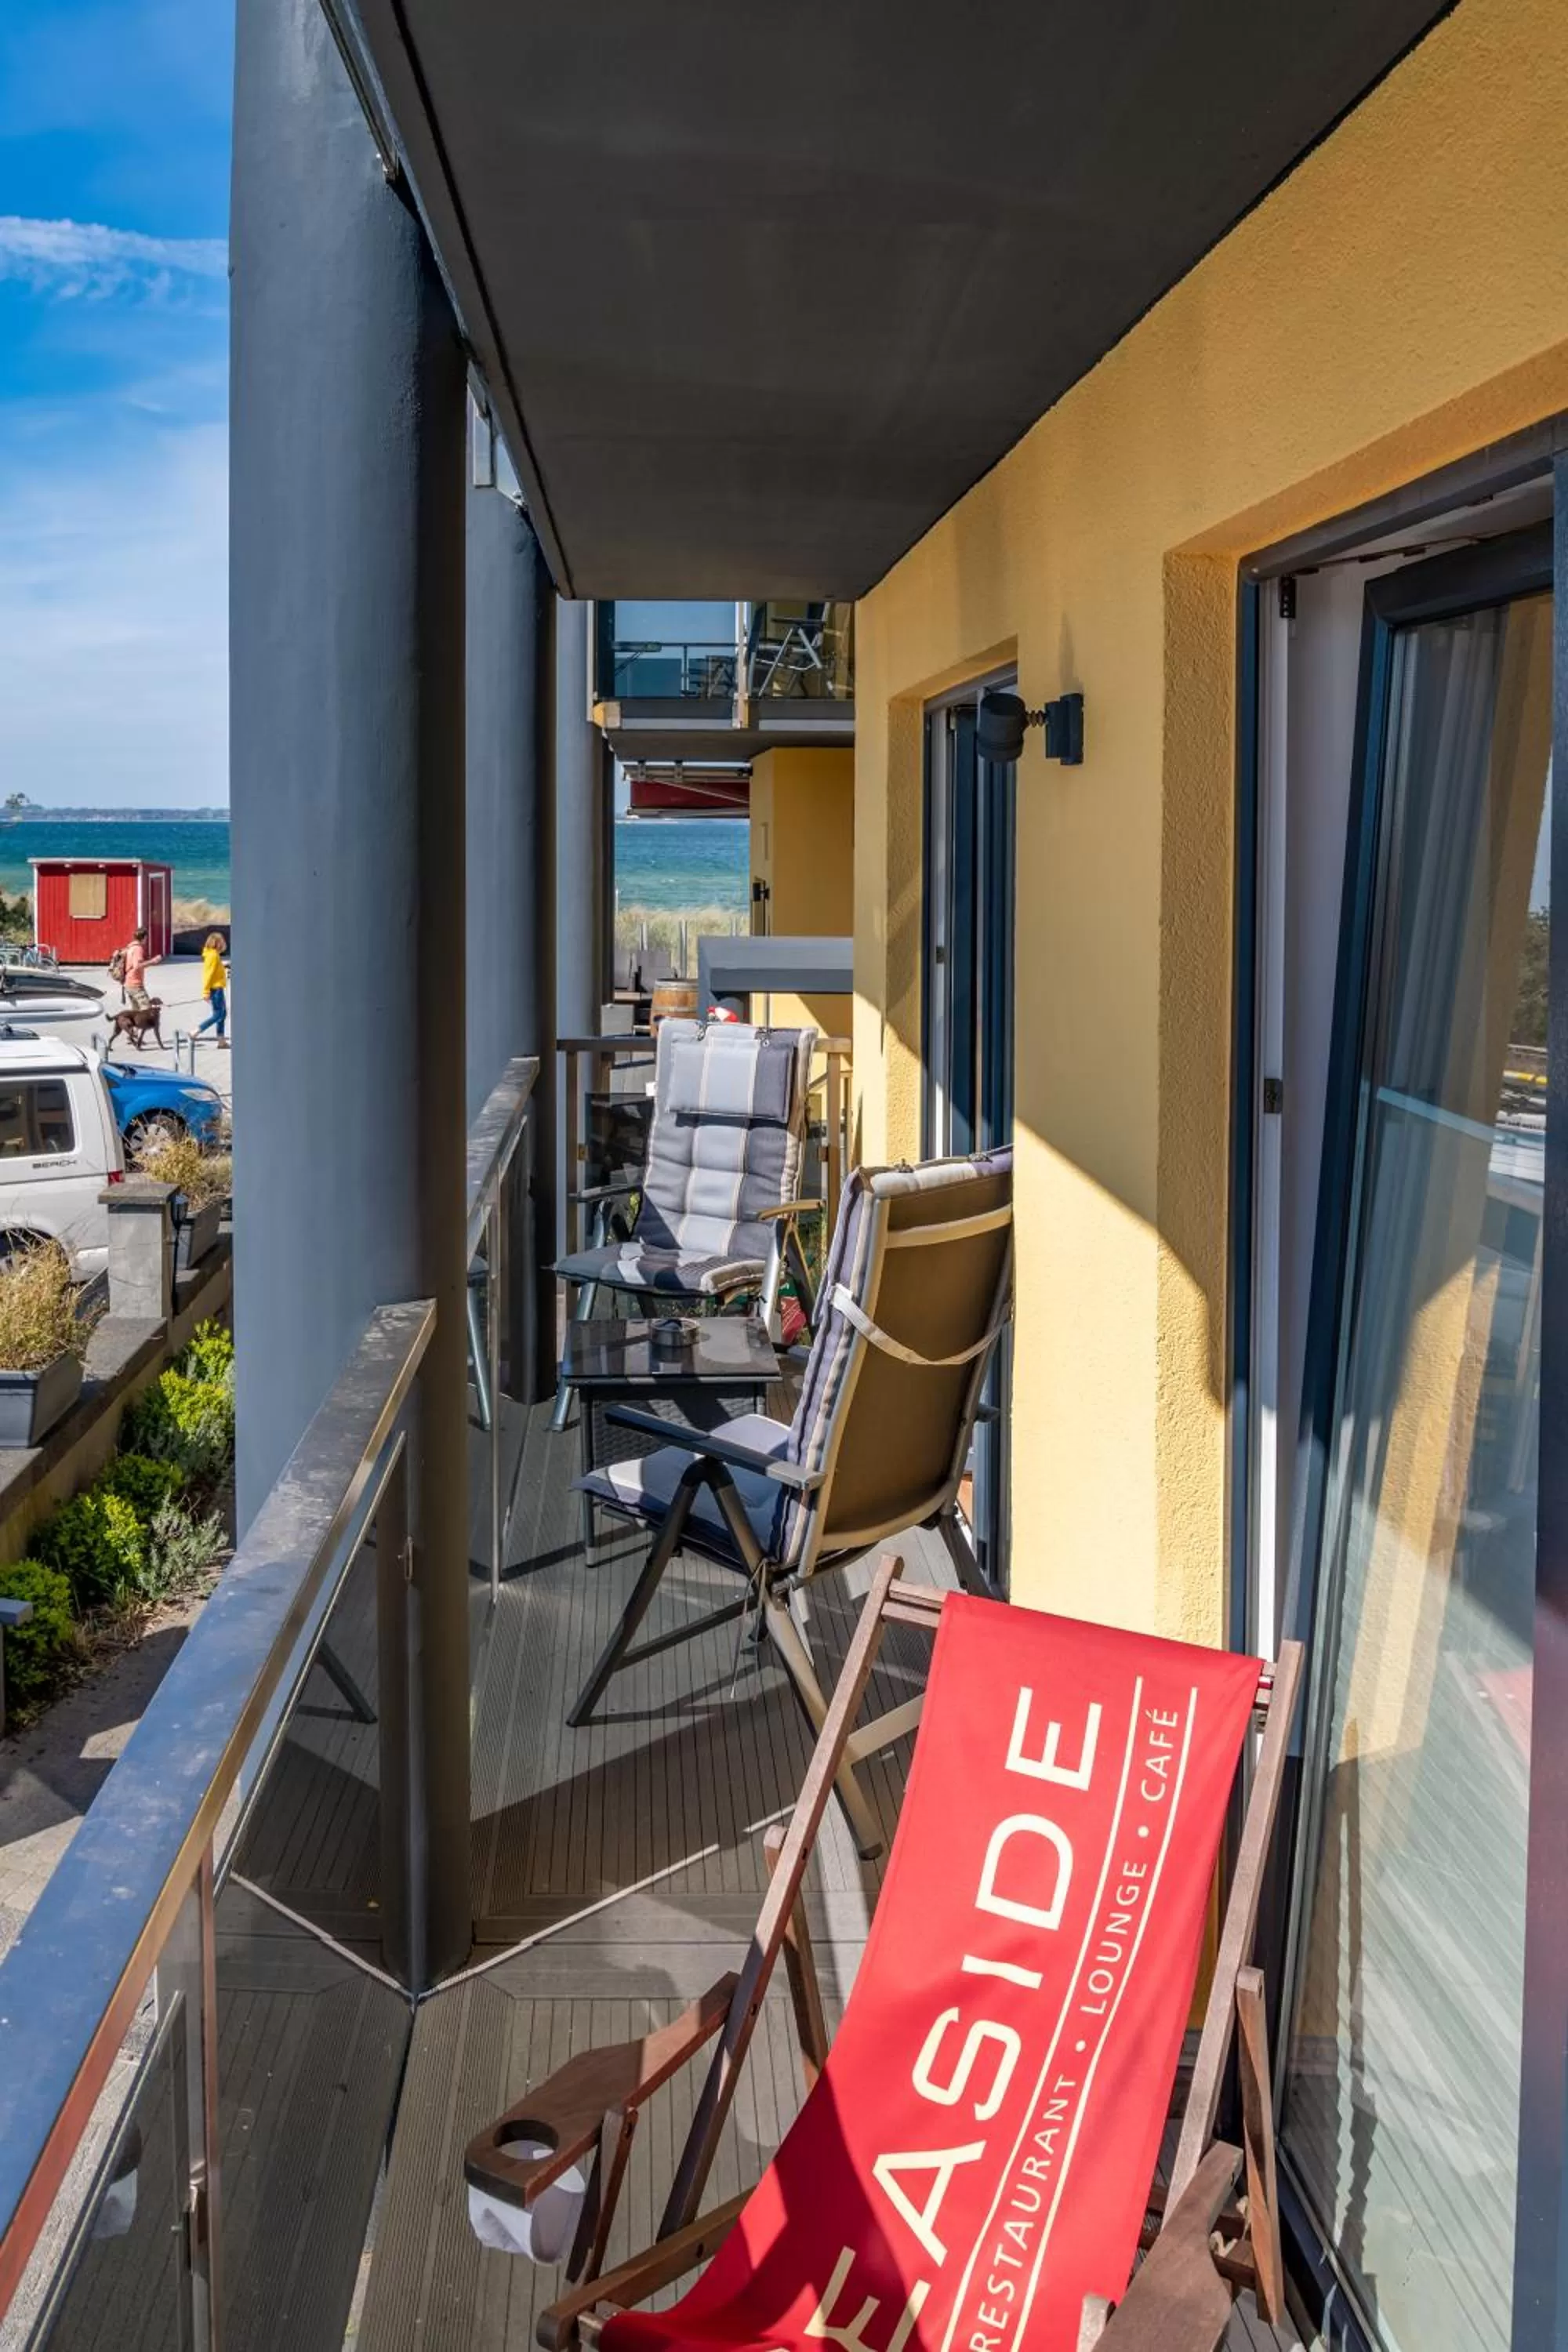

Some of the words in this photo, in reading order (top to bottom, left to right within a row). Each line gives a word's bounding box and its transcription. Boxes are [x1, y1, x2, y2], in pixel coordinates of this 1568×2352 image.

[764, 1686, 1102, 2352] EASIDE
[968, 2075, 1076, 2352] RESTAURANT
[1080, 1861, 1147, 2015] LOUNGE
[1141, 1708, 1178, 1802] CAFÉ
